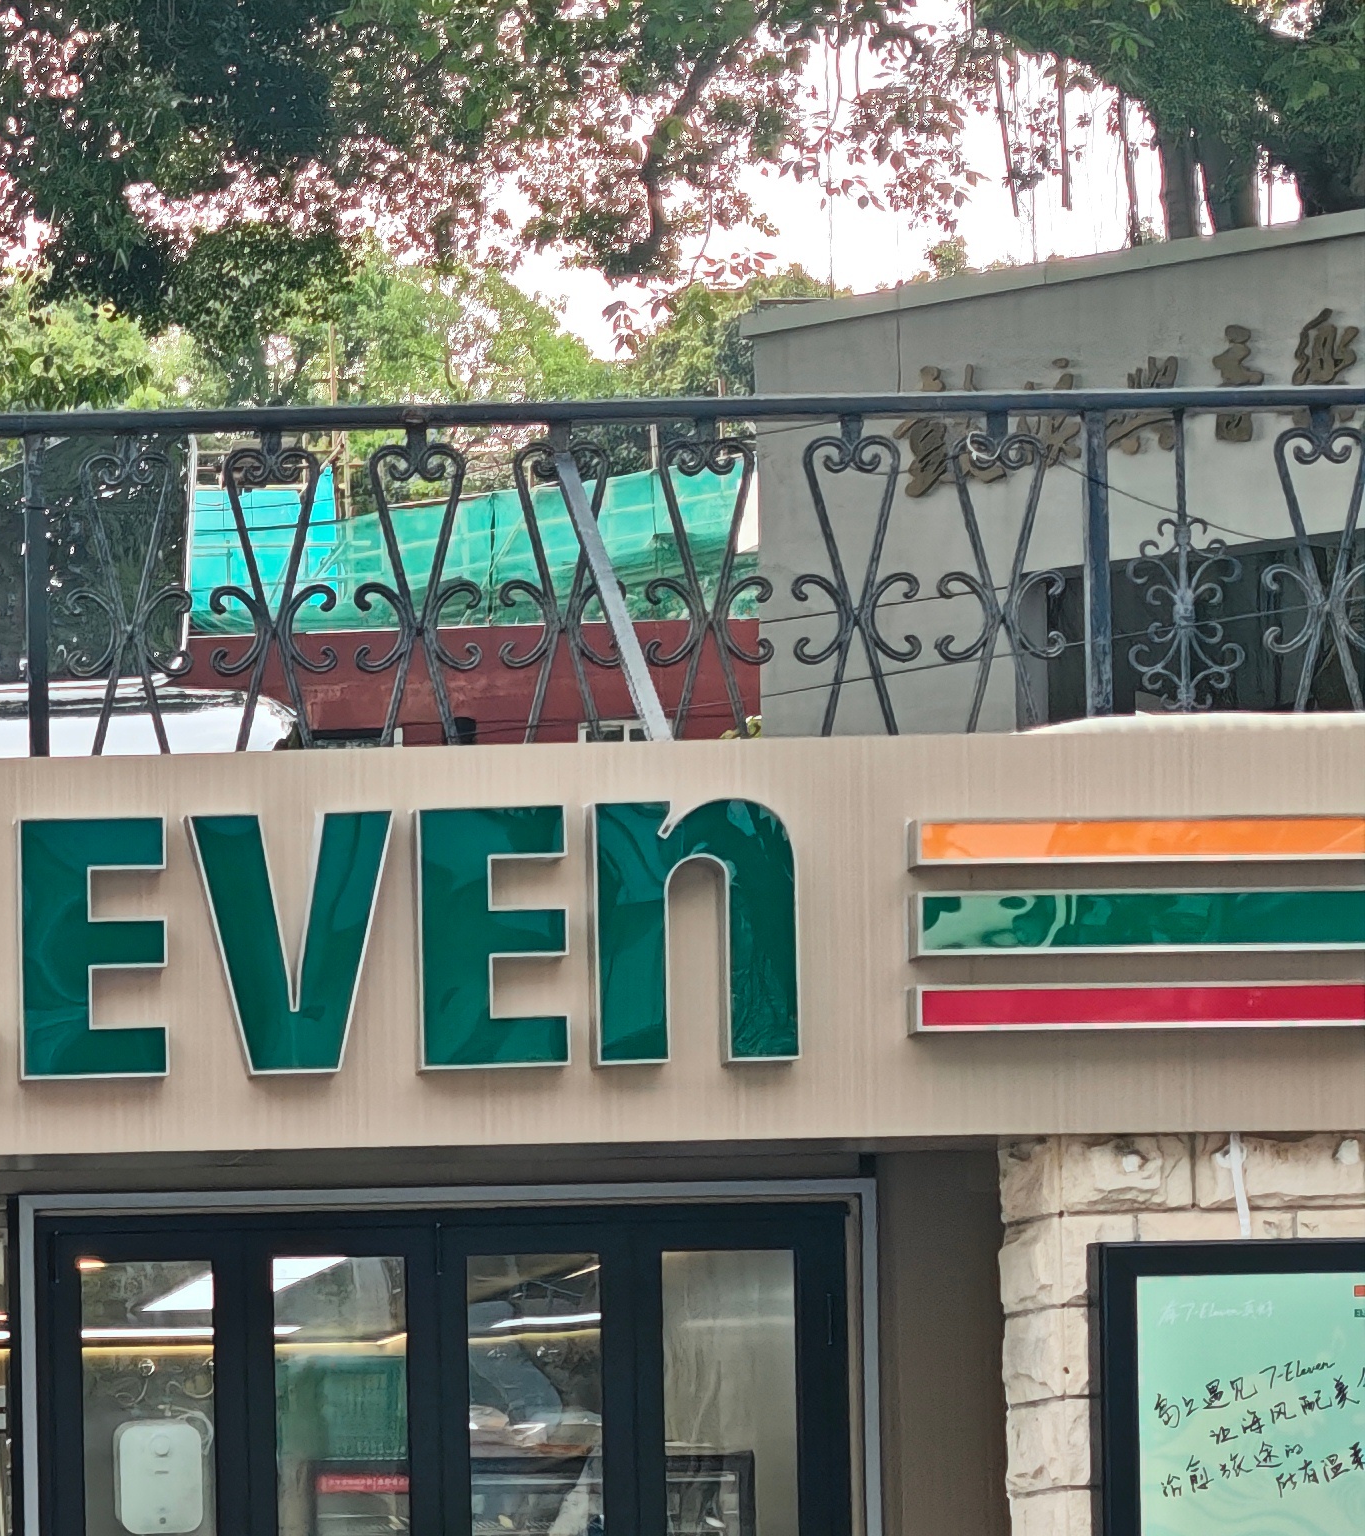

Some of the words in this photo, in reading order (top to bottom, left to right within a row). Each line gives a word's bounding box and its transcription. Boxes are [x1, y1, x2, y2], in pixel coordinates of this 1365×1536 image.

[1209, 1367, 1365, 1444] 让海风配美
